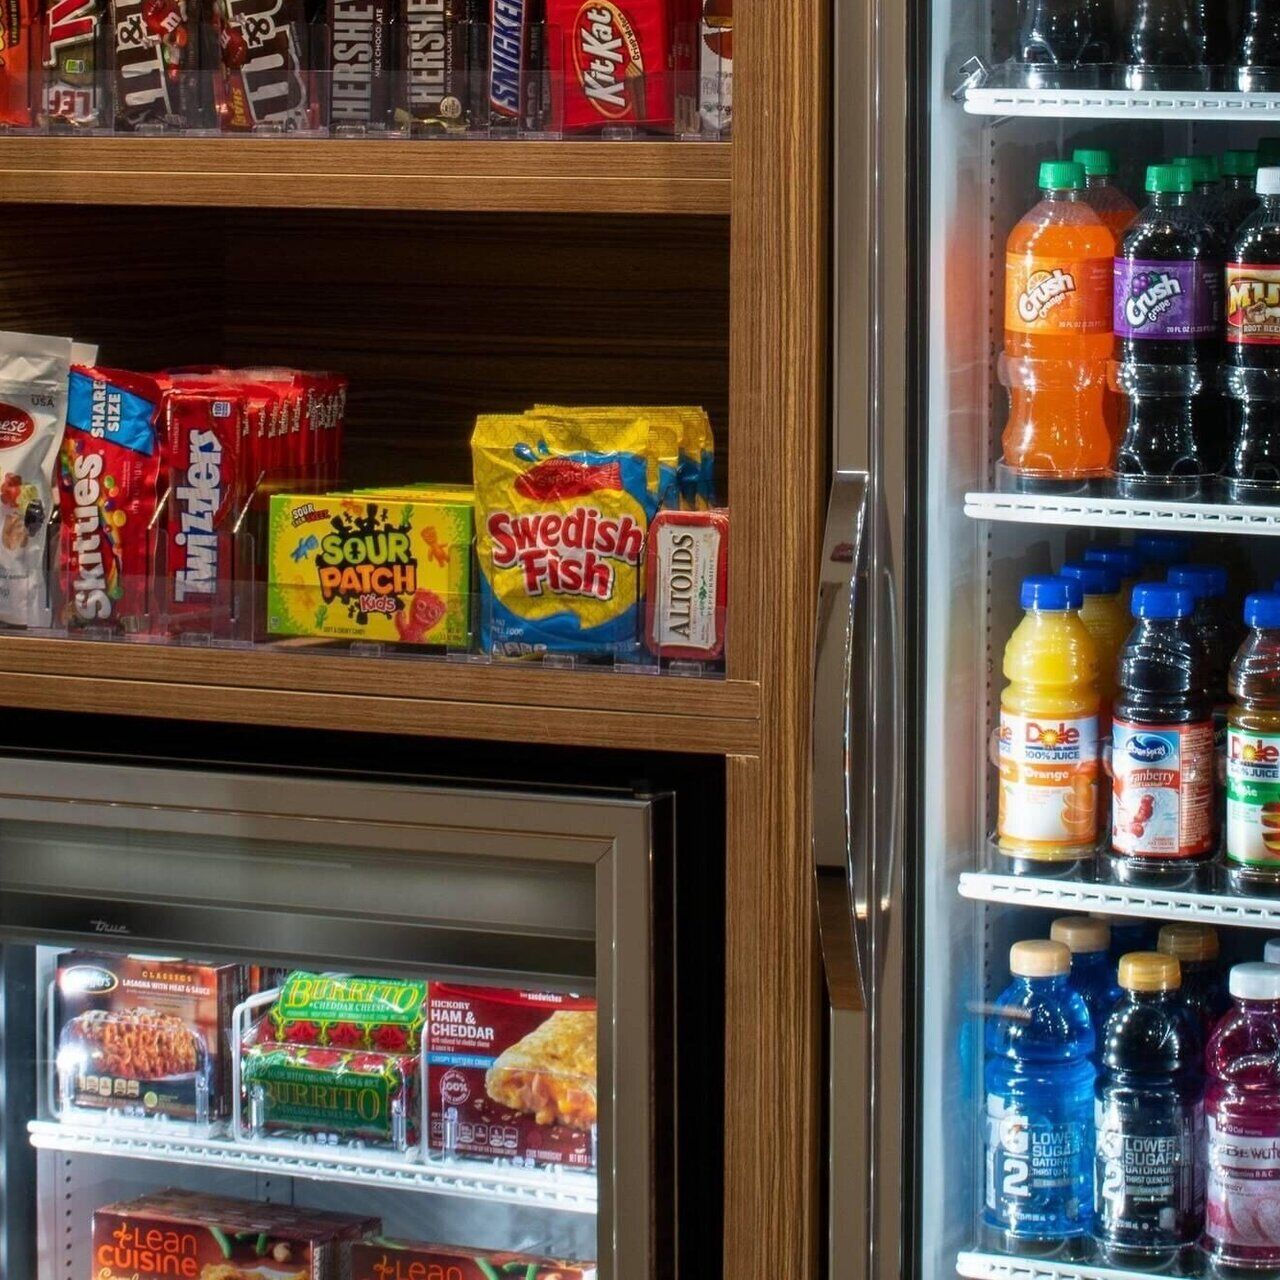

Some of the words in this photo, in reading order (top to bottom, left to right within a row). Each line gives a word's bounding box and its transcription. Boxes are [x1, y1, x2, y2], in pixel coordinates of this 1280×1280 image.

[1018, 269, 1075, 323] Crush
[1125, 272, 1181, 328] Crush
[1148, 300, 1171, 322] Grape
[1243, 324, 1262, 334] ROOT
[31, 396, 55, 408] USA
[91, 380, 107, 438] SHARE
[107, 392, 121, 433] SIZE
[174, 429, 222, 602] Twizzlers
[292, 504, 315, 519] SOUR
[488, 508, 645, 564] Swedish
[321, 532, 410, 566] SOUR
[320, 566, 416, 600] PATCH
[519, 549, 613, 598] Fish
[670, 533, 694, 638] ALTOIDS
[359, 594, 397, 612] Kids
[1024, 722, 1080, 745] Dole
[1025, 750, 1051, 760] 100%
[1052, 750, 1080, 760] JUICE
[1232, 735, 1280, 763] Dole
[1251, 768, 1279, 778] JUICE
[122, 979, 150, 990] LASAGNA
[152, 982, 168, 991] WITH
[141, 970, 193, 982] CLASSICS
[286, 978, 418, 1011] BURRITO
[431, 999, 470, 1010] HICKORY
[431, 1010, 462, 1023] HAM
[465, 1012, 477, 1024] &
[431, 1024, 494, 1040] CHEDDAR
[1124, 1139, 1176, 1152] LOWER
[1124, 1152, 1177, 1165] SUGAR
[135, 1228, 196, 1255] Lean
